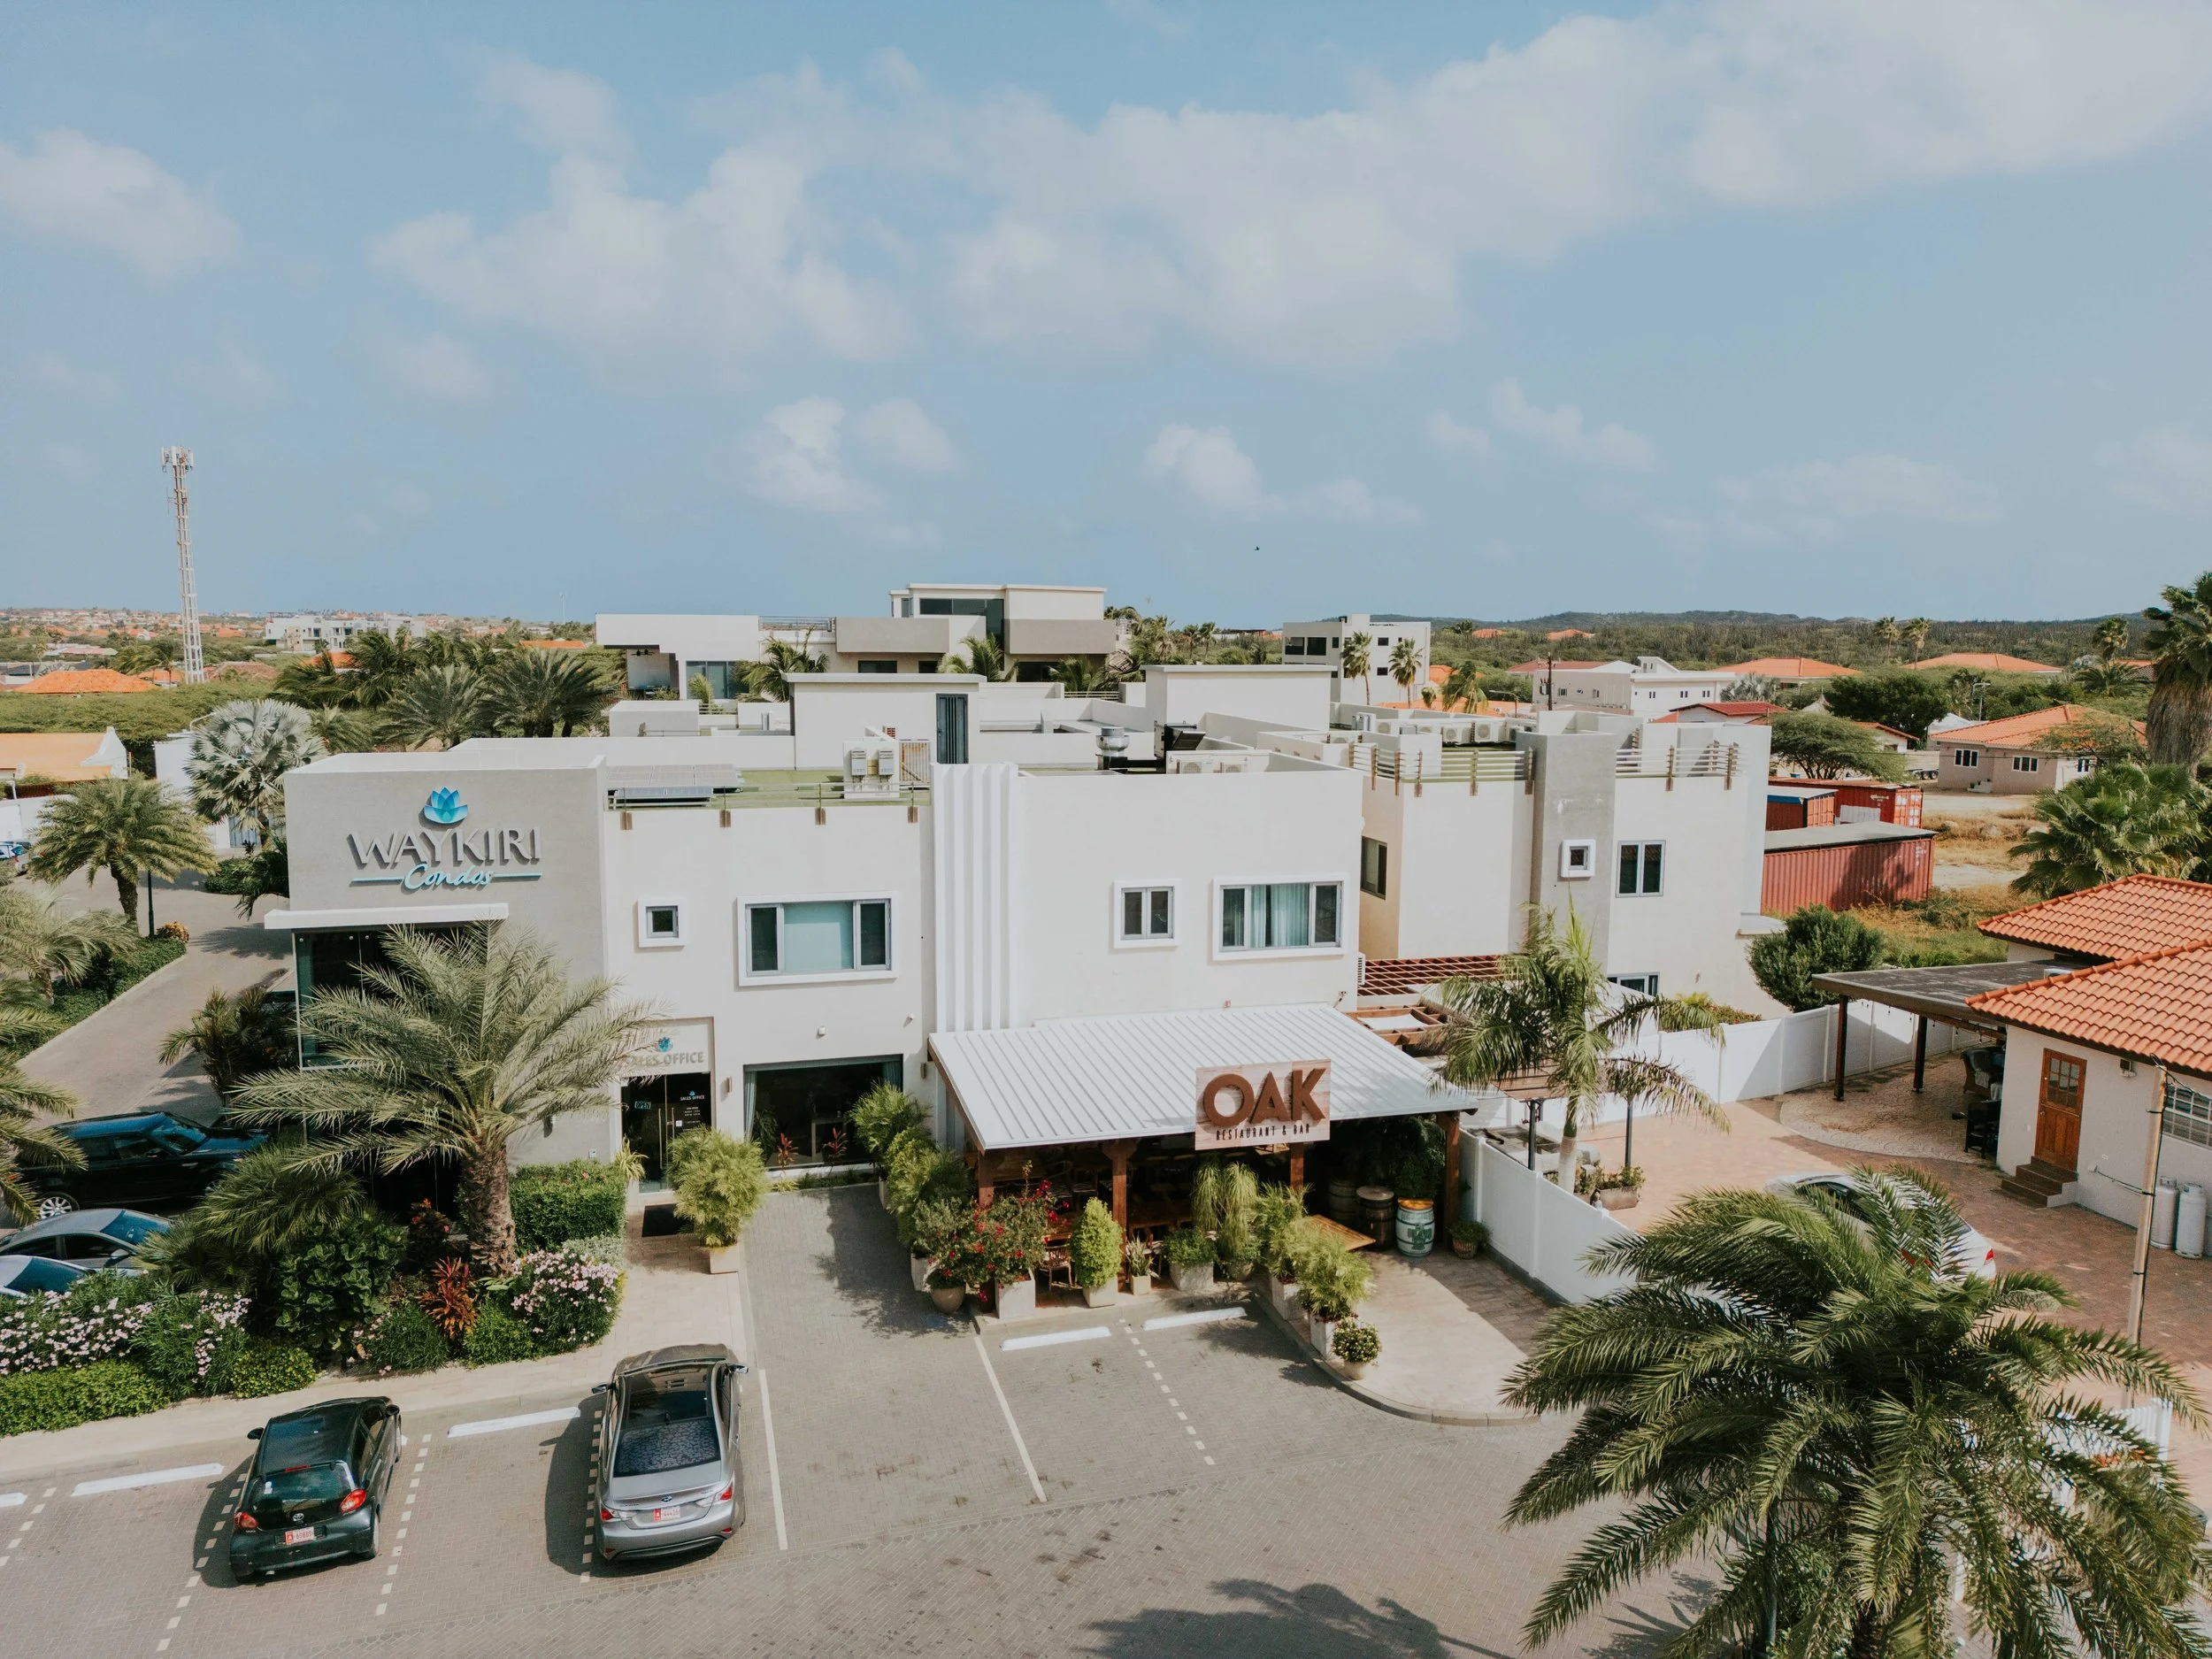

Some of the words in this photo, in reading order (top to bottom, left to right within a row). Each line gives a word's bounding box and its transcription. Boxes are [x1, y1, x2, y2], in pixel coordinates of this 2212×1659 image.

[348, 828, 541, 867] WAYKIRI
[404, 864, 493, 890] Condos
[664, 1051, 704, 1065] OFFICE
[1203, 1068, 1325, 1127] OAK
[1216, 1125, 1275, 1141] RESTAURANT
[1282, 1125, 1286, 1136] &
[1293, 1123, 1310, 1134] BAR
